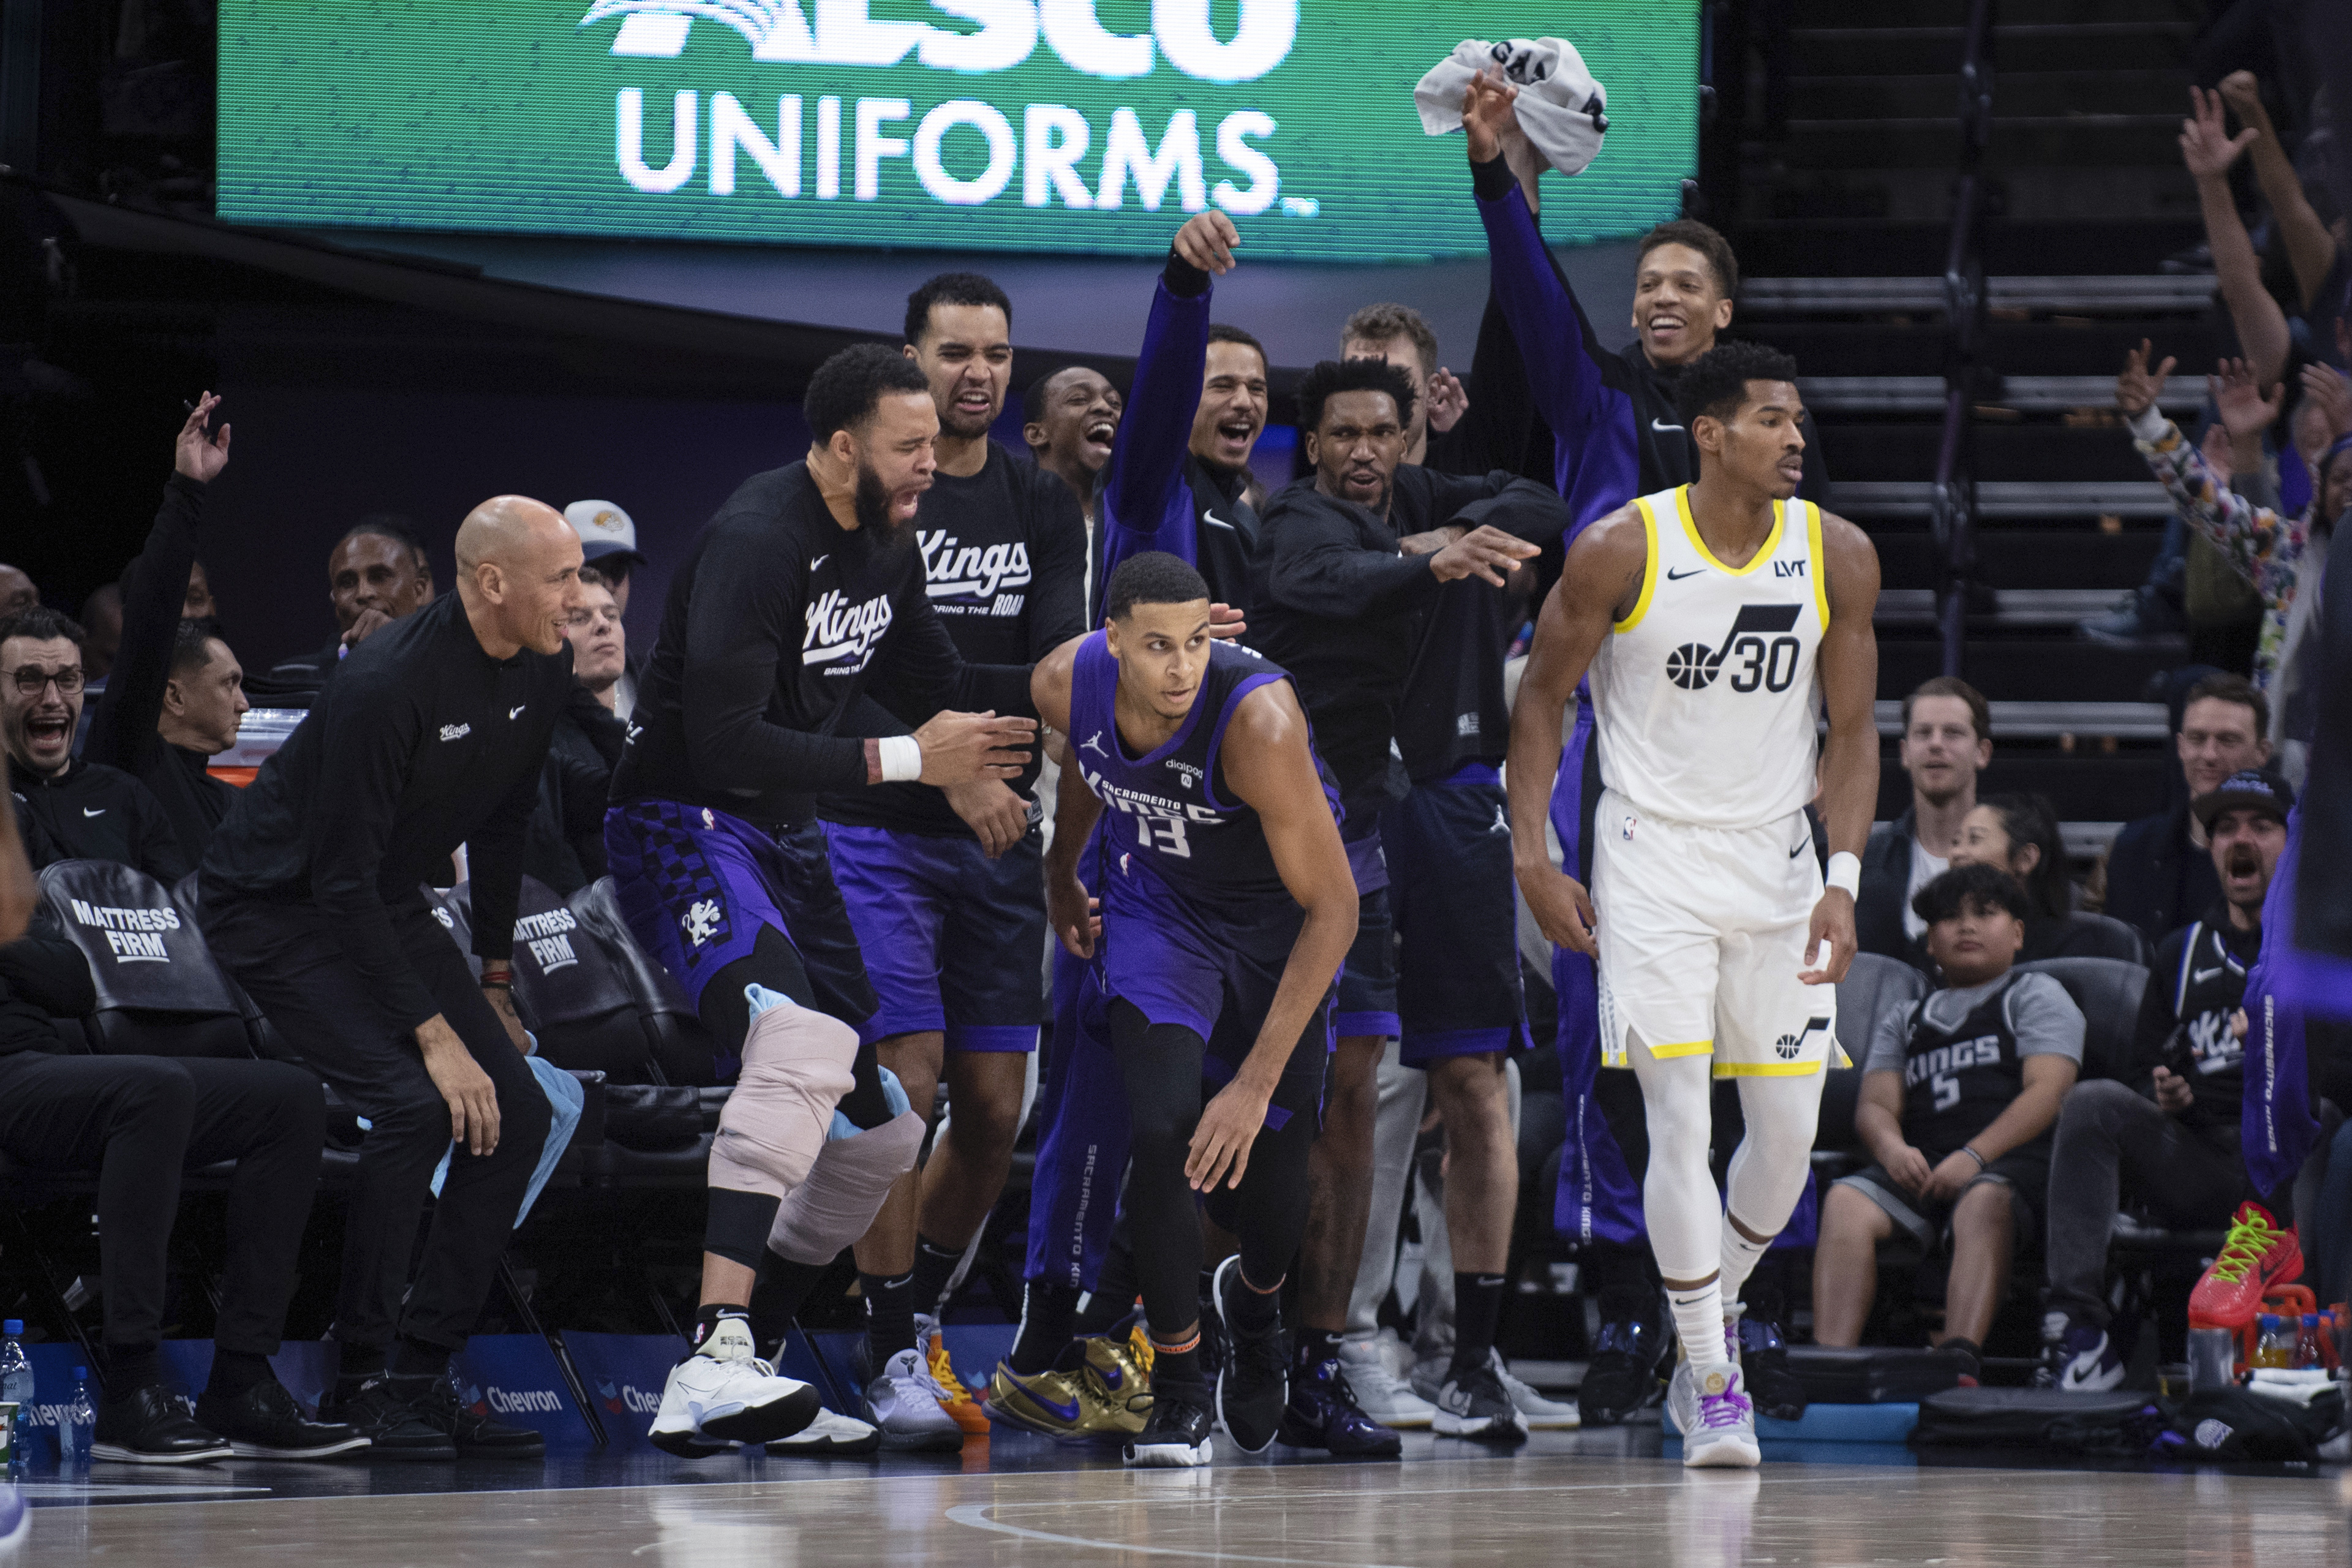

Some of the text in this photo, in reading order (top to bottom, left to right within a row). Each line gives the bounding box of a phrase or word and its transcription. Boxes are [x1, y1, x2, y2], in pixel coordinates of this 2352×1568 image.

[1774, 560, 1806, 578] LVT
[968, 605, 989, 614] THE
[802, 589, 892, 665] Kings
[823, 666, 850, 676] BRING
[1730, 636, 1801, 693] 30
[439, 723, 471, 741] Kings
[1166, 759, 1204, 780] dialpad
[1102, 780, 1181, 810] SACRAMENTO
[1136, 816, 1191, 858] 13
[71, 899, 180, 930] MATTRESS
[105, 930, 167, 957] FIRM
[528, 933, 575, 966] FIRM
[1905, 1035, 2001, 1088] KINGS
[1932, 1073, 1961, 1112] 5
[1072, 1144, 1098, 1256] SACRAMENTO
[487, 1387, 562, 1412] Chevron
